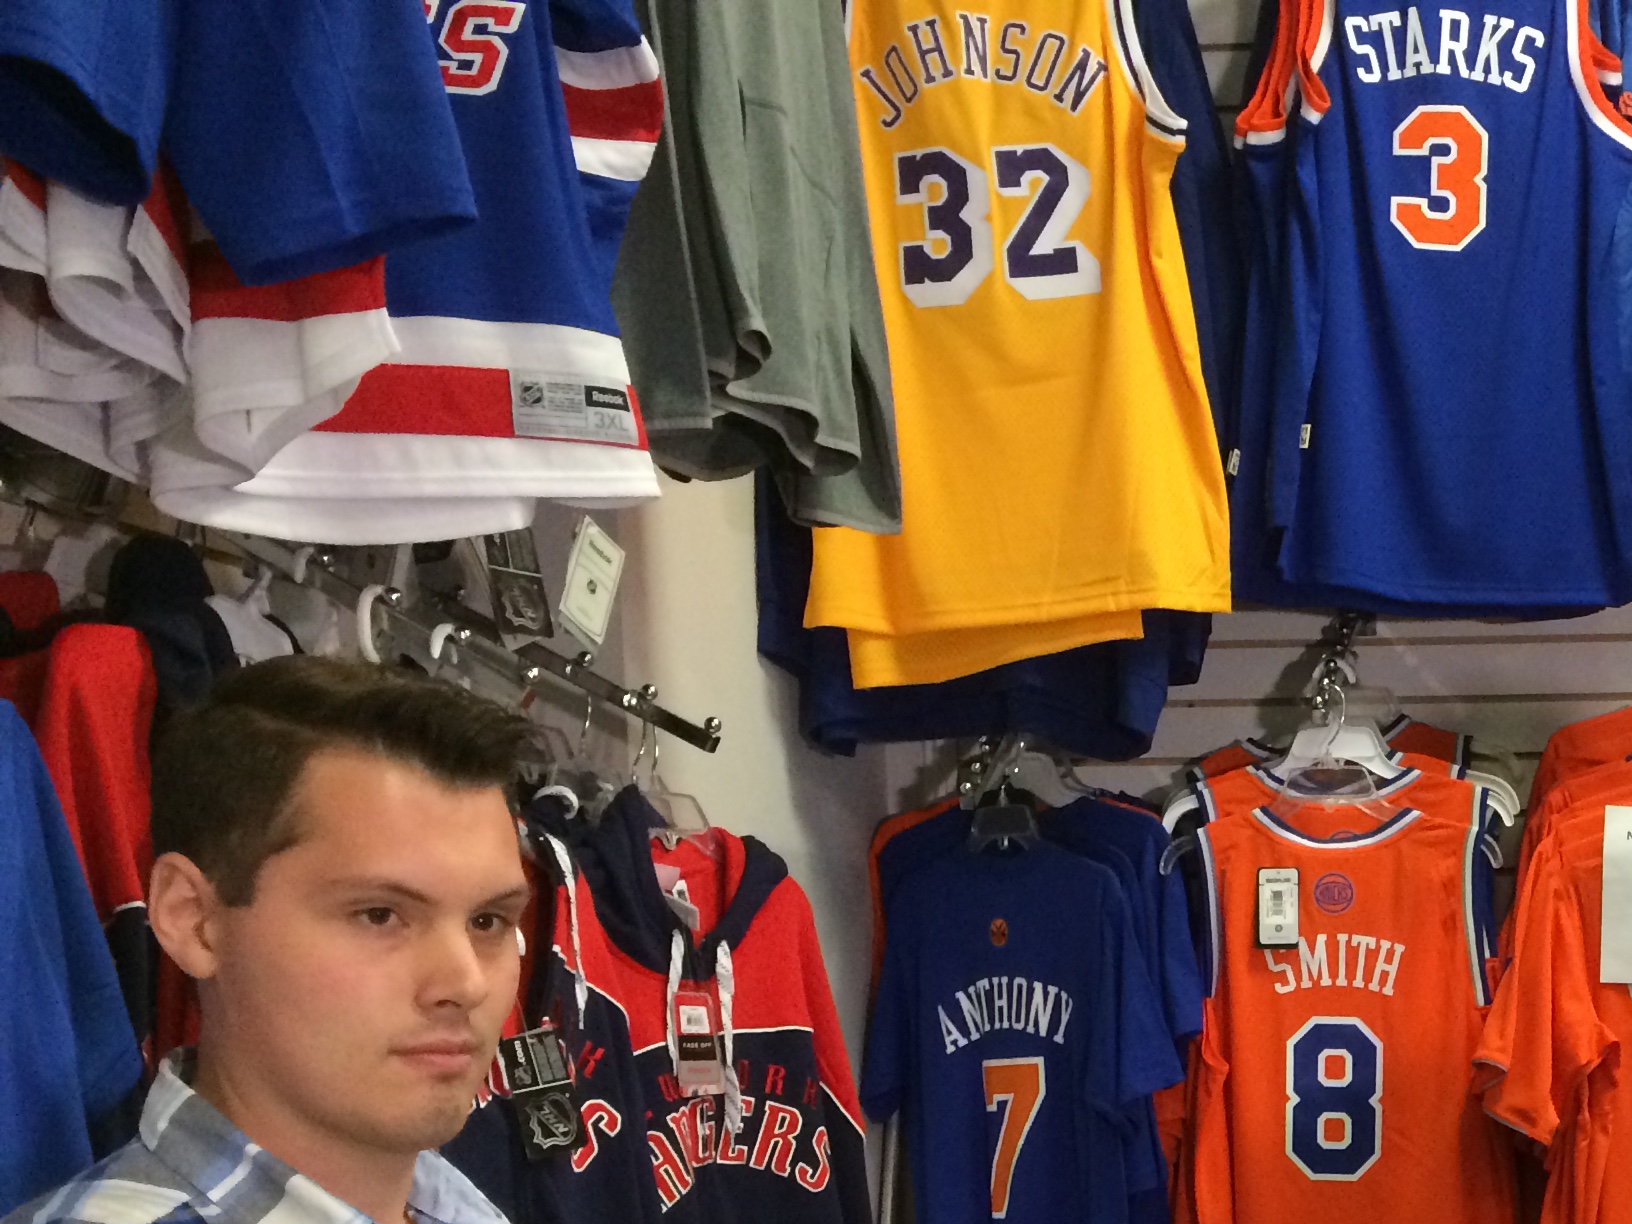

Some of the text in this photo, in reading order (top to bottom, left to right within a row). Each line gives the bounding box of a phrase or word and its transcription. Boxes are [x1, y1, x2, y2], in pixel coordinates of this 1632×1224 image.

[859, 10, 1110, 131] JOHNSON
[1345, 7, 1546, 93] STARKS
[893, 143, 1102, 308] 32
[1391, 105, 1489, 252] 3
[594, 411, 628, 432] 3XL
[938, 976, 1074, 1055] ANTHONY
[1263, 933, 1406, 996] SMITH
[982, 1056, 1045, 1219] 7
[1286, 1016, 1383, 1181] 8
